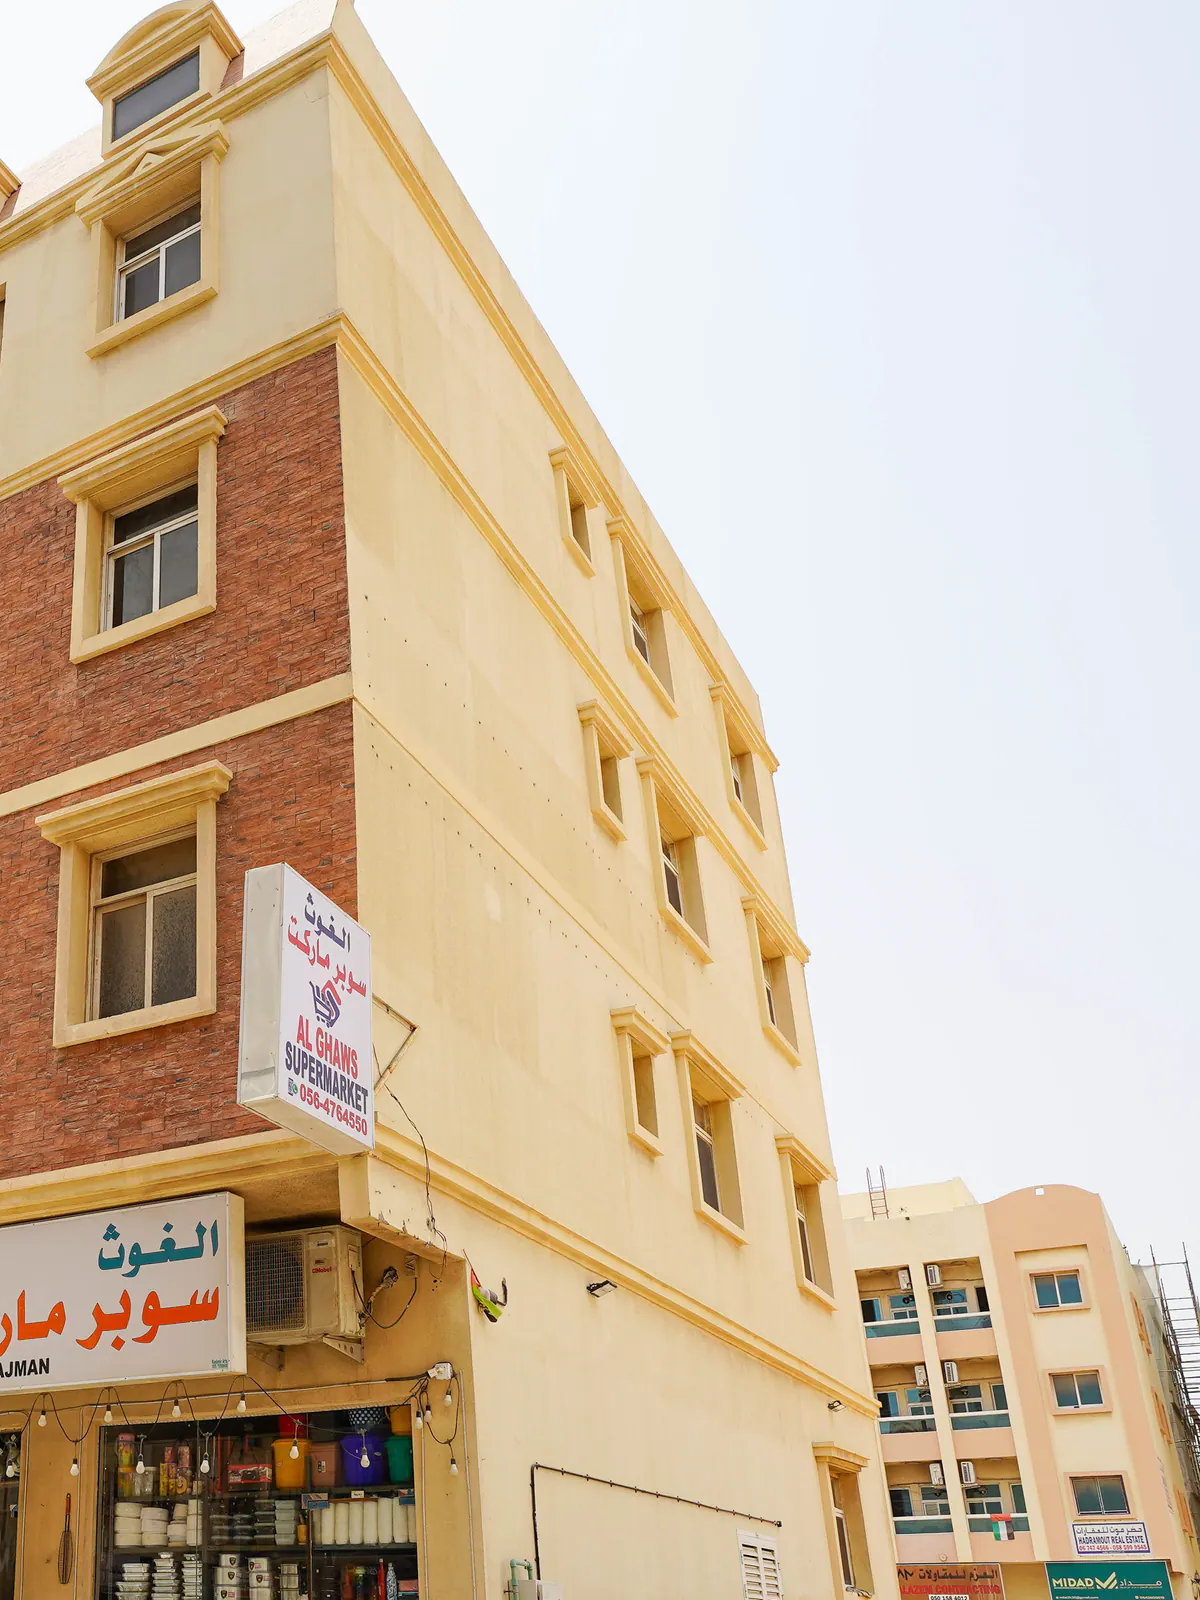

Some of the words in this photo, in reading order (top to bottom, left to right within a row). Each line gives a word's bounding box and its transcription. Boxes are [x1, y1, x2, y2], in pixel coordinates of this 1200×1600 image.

[287, 915, 330, 970] ماركت
[304, 892, 351, 953] الغوث
[332, 963, 367, 997] سوبر
[296, 1014, 313, 1052] AL
[315, 1027, 358, 1080] GHAWS
[285, 1040, 368, 1115] SUPERMARKET
[299, 1083, 368, 1136] 056-4764550
[97, 1219, 220, 1278] الغوث
[75, 1286, 220, 1352] سوبر
[1078, 1536, 1110, 1544] HADRAMOUT
[1111, 1536, 1125, 1544] REAL
[1126, 1535, 1145, 1544] ESTATE
[919, 1568, 966, 1582] للمقاولات
[935, 1585, 1001, 1595] CONTRACTING
[969, 1568, 998, 1581] العزم
[1052, 1577, 1095, 1587] MIDAD
